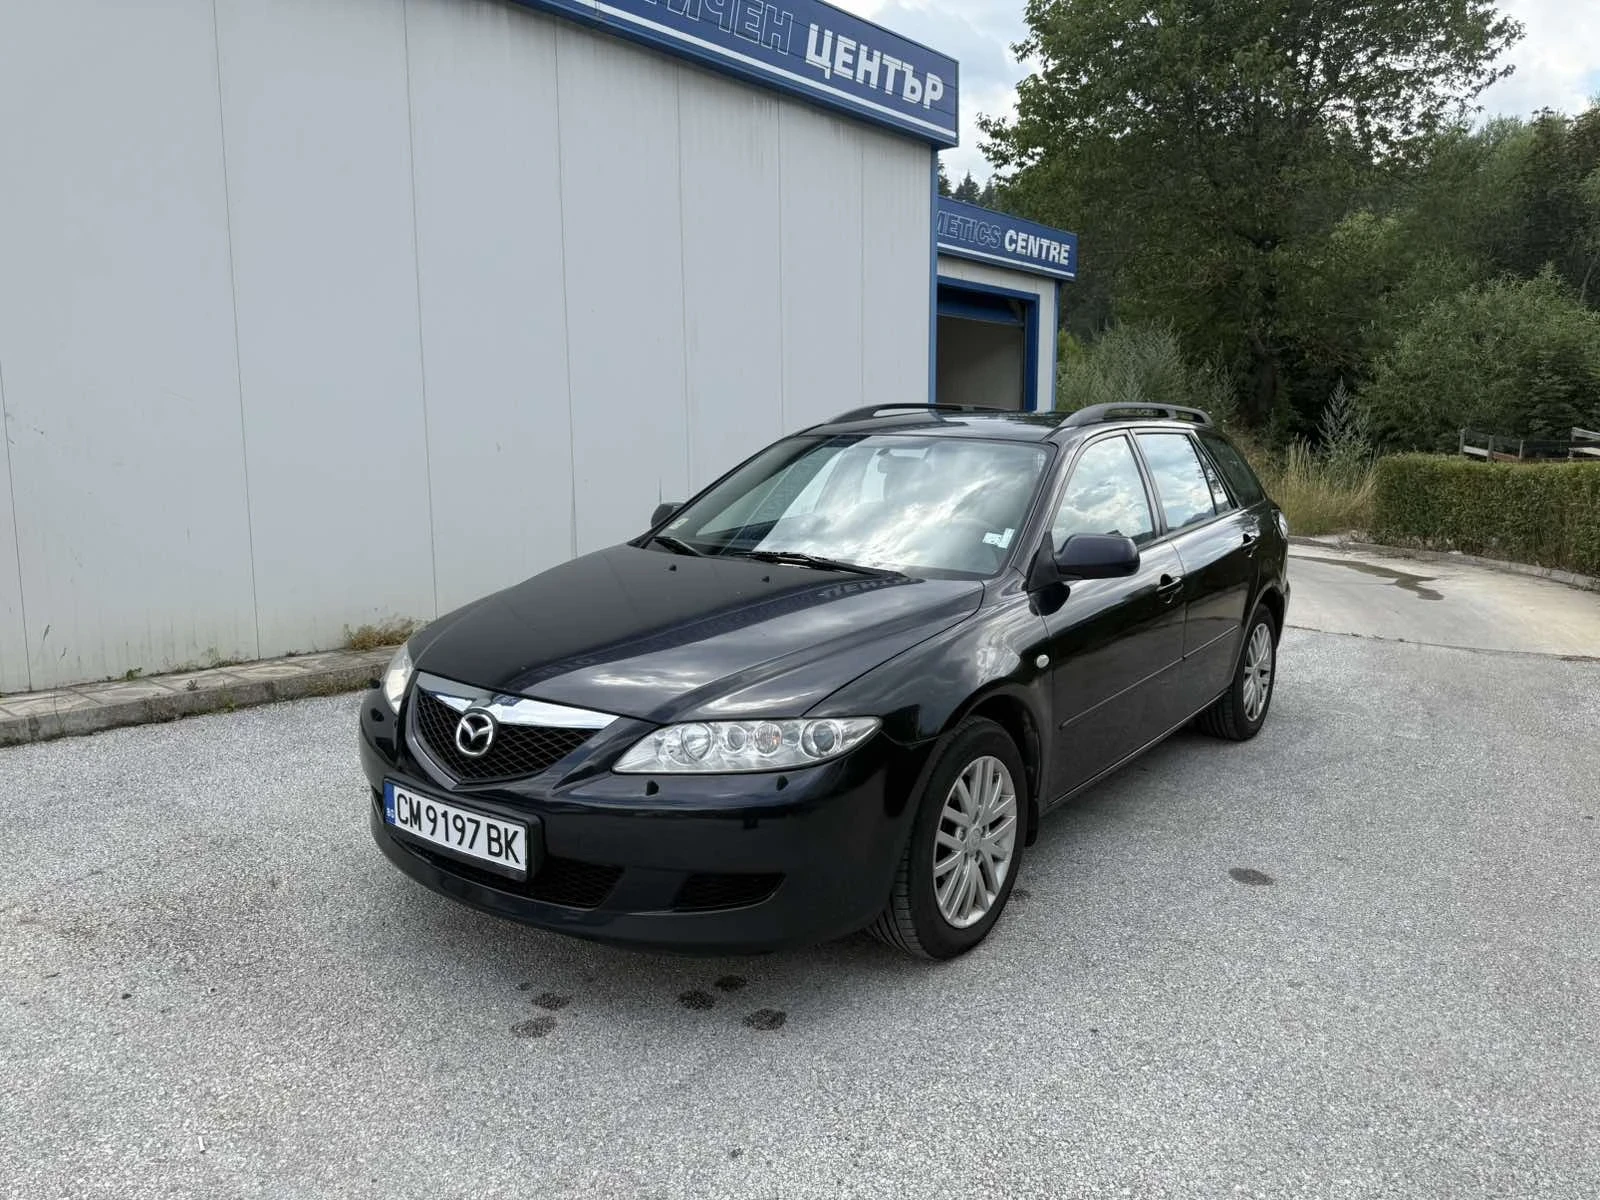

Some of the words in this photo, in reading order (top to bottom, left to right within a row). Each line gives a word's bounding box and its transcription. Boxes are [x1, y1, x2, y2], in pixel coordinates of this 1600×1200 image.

[805, 23, 944, 109] ЦЕНТЪР
[1004, 229, 1071, 266] CENTRE
[397, 793, 422, 831] CM
[425, 805, 481, 849] 9197
[486, 823, 520, 864] BK
